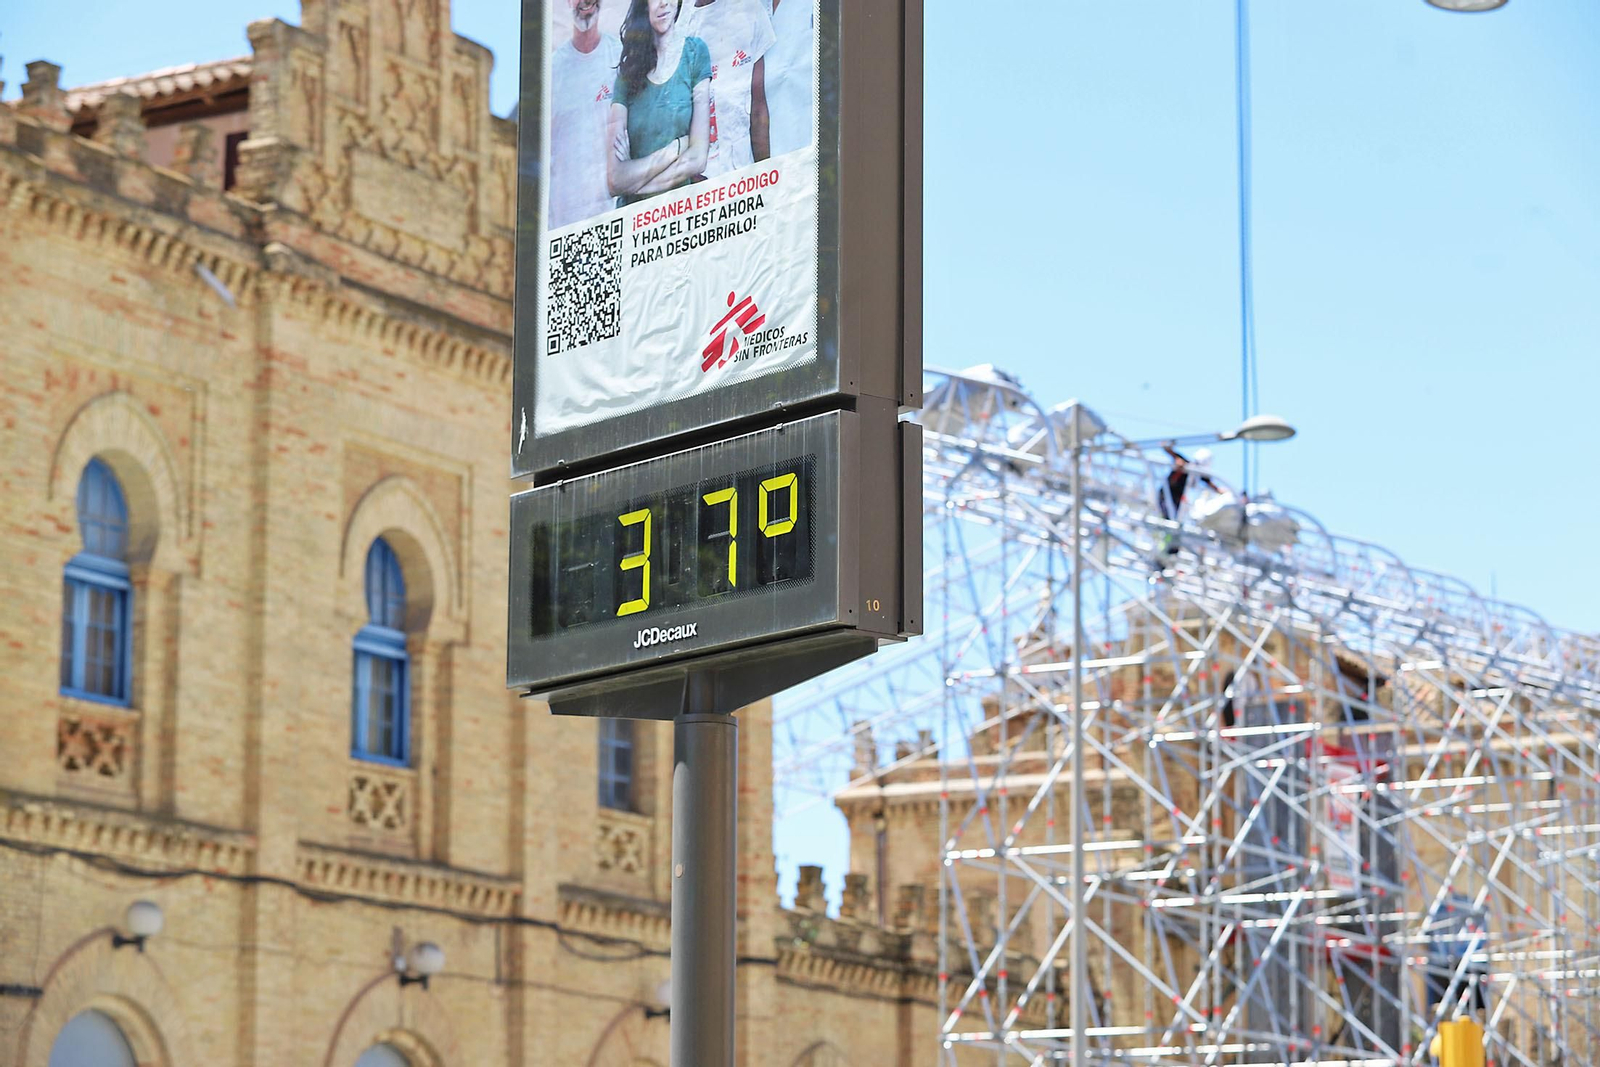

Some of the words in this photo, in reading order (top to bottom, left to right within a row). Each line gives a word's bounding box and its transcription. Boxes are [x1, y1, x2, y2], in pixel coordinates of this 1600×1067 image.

[632, 197, 693, 231] ¡ESCANEA
[696, 186, 726, 209] ESTE
[728, 169, 780, 198] CÓDIGO
[632, 233, 640, 248] Y
[642, 224, 667, 246] HAZ
[669, 220, 683, 237] EL
[686, 209, 716, 231] TEST
[718, 193, 765, 221] AHORA
[631, 245, 664, 268] PARA
[666, 215, 757, 257] DESCUBRIRLO!
[733, 348, 750, 363] SIN
[753, 332, 809, 358] FRONTERAS
[865, 599, 880, 612] 10
[633, 622, 698, 649] JCDecaux
